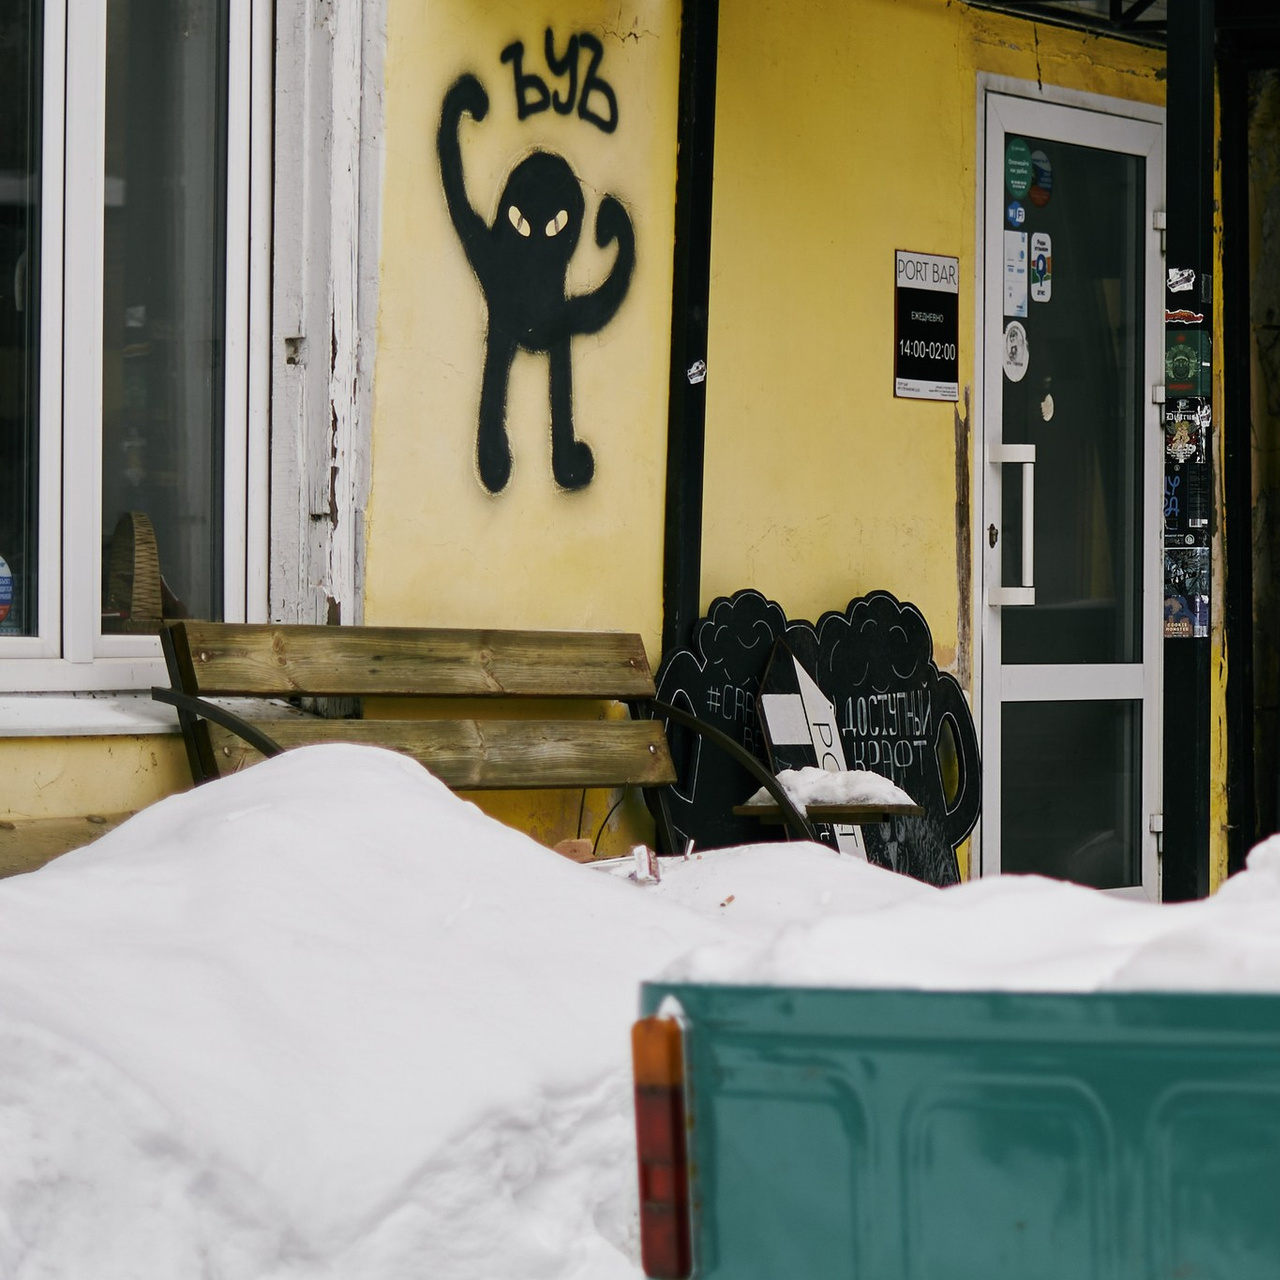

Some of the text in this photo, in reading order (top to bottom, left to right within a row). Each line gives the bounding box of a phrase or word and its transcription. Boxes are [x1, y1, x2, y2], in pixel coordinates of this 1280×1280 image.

[898, 259, 957, 286] PORT BAR
[911, 310, 944, 323] ЕЖЕДНЕВНО
[899, 339, 956, 361] 14:00-02:00
[842, 682, 932, 738] ДОСТУПНЫЙ
[853, 740, 927, 782] КРАФТ
